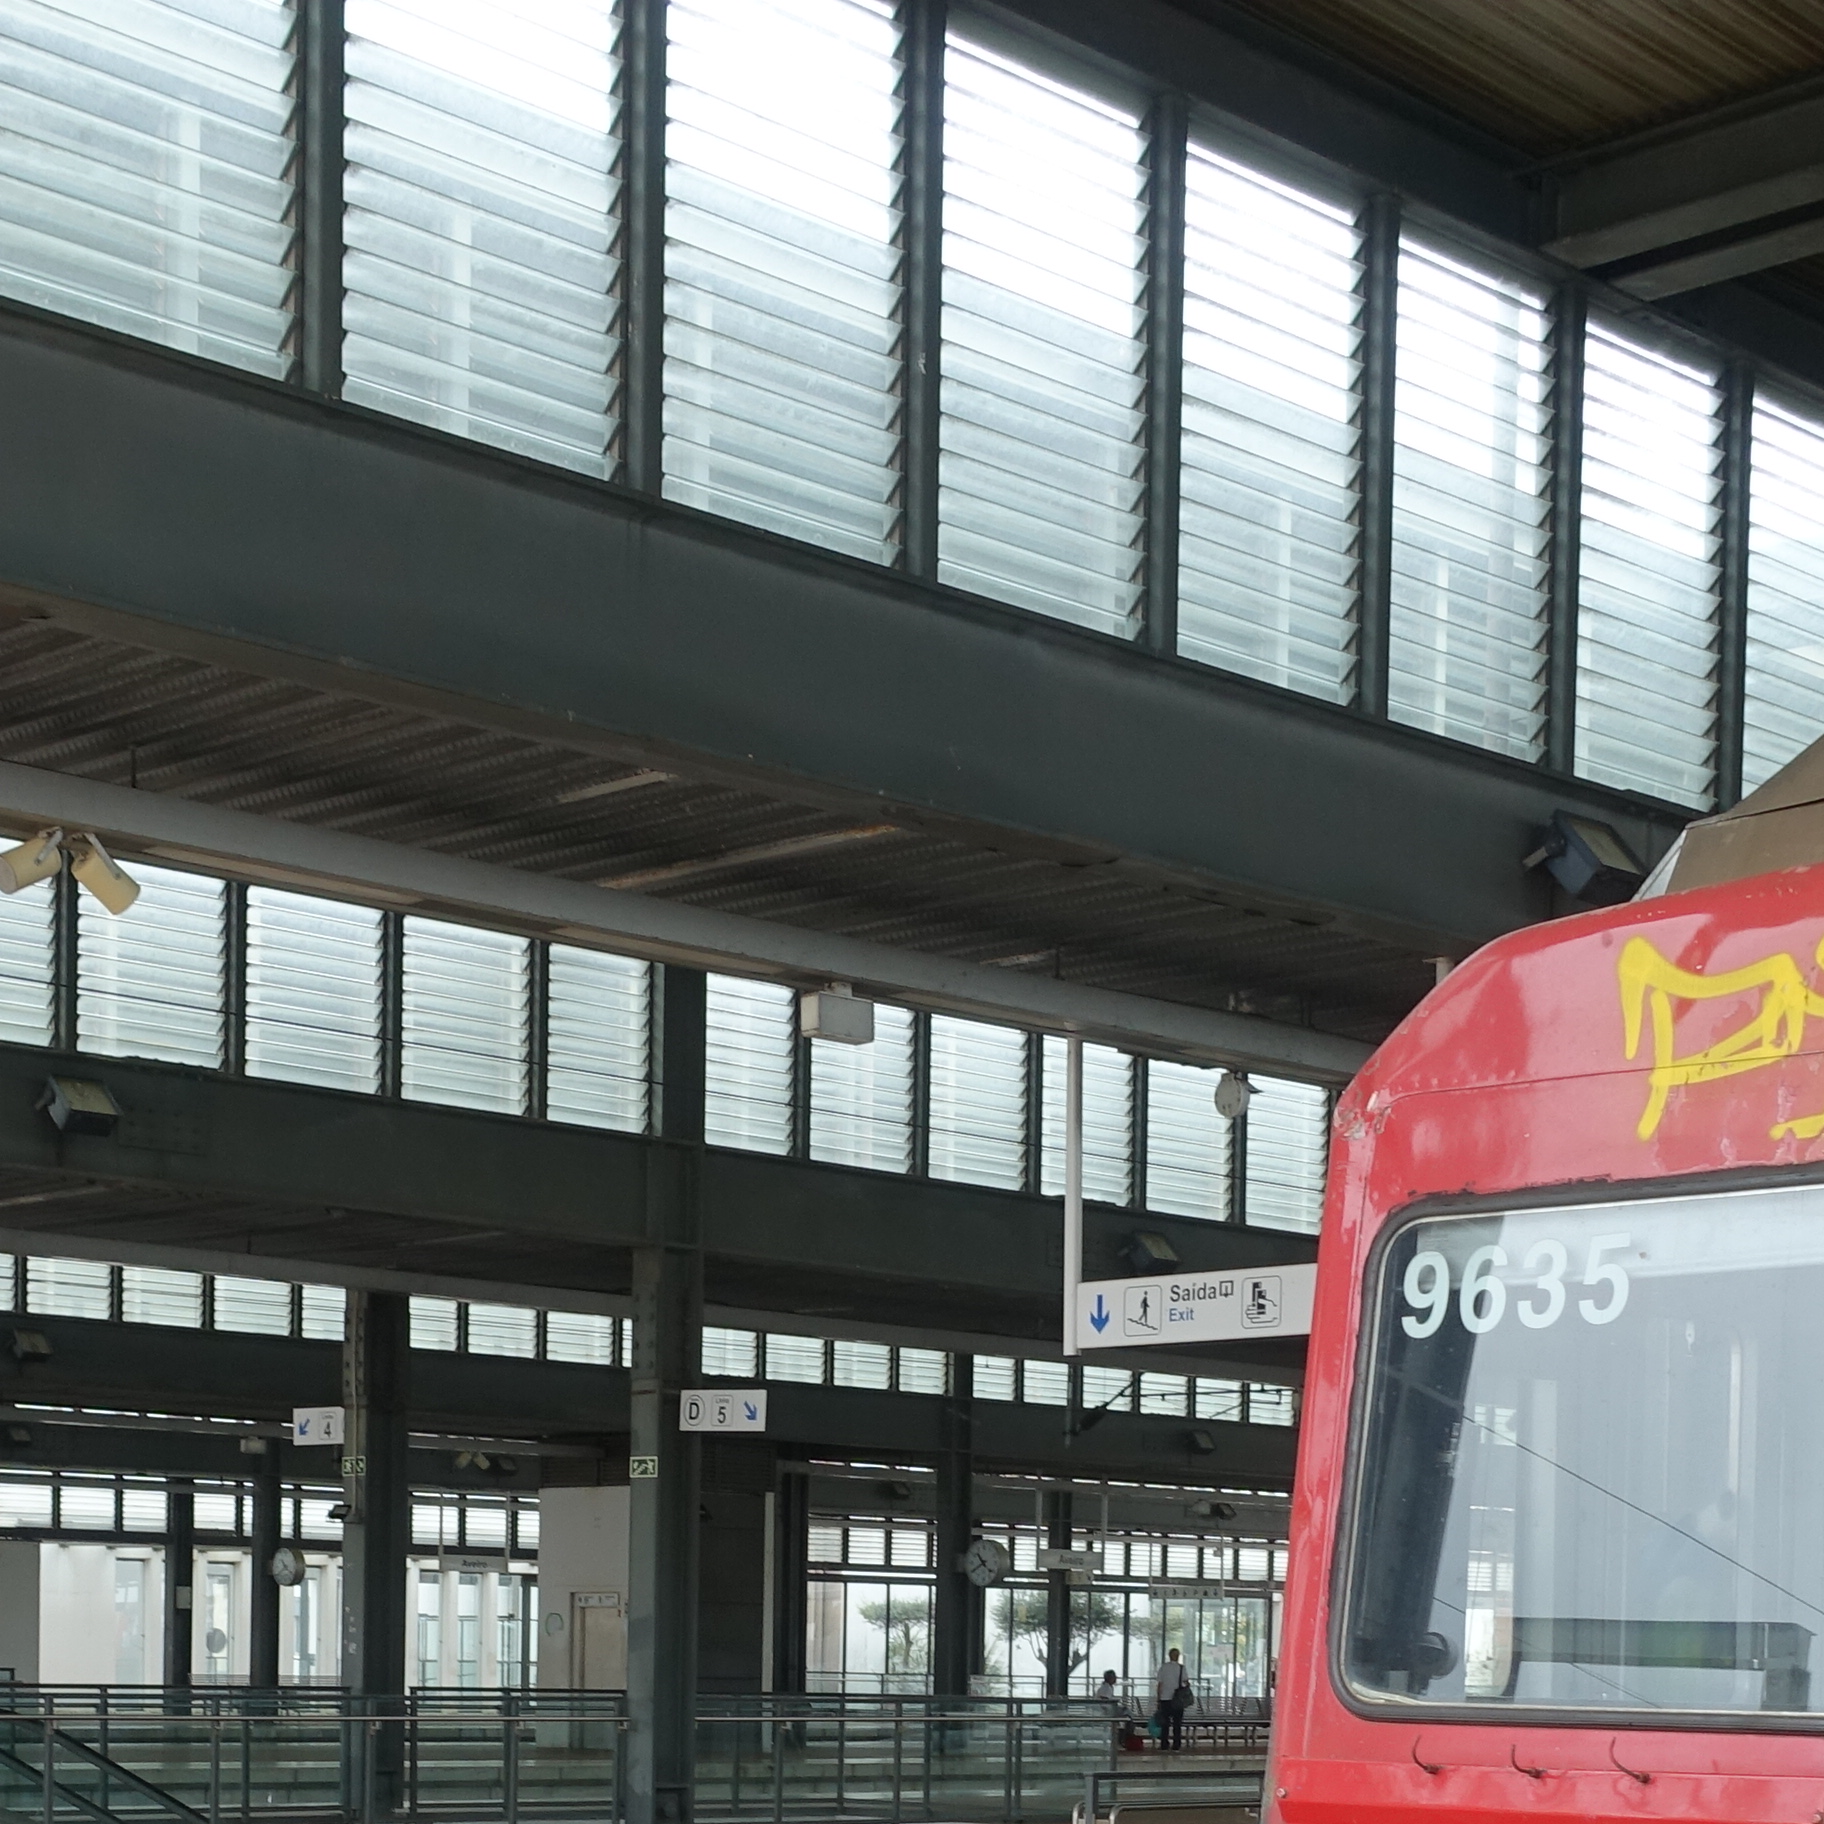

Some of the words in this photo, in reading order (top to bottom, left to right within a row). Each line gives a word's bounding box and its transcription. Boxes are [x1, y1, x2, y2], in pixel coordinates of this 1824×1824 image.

[1401, 1232, 1631, 1340] 9635
[1168, 1307, 1195, 1322] Exit
[688, 1402, 700, 1420] D
[717, 1406, 727, 1424] 5
[323, 1421, 331, 1439] 4
